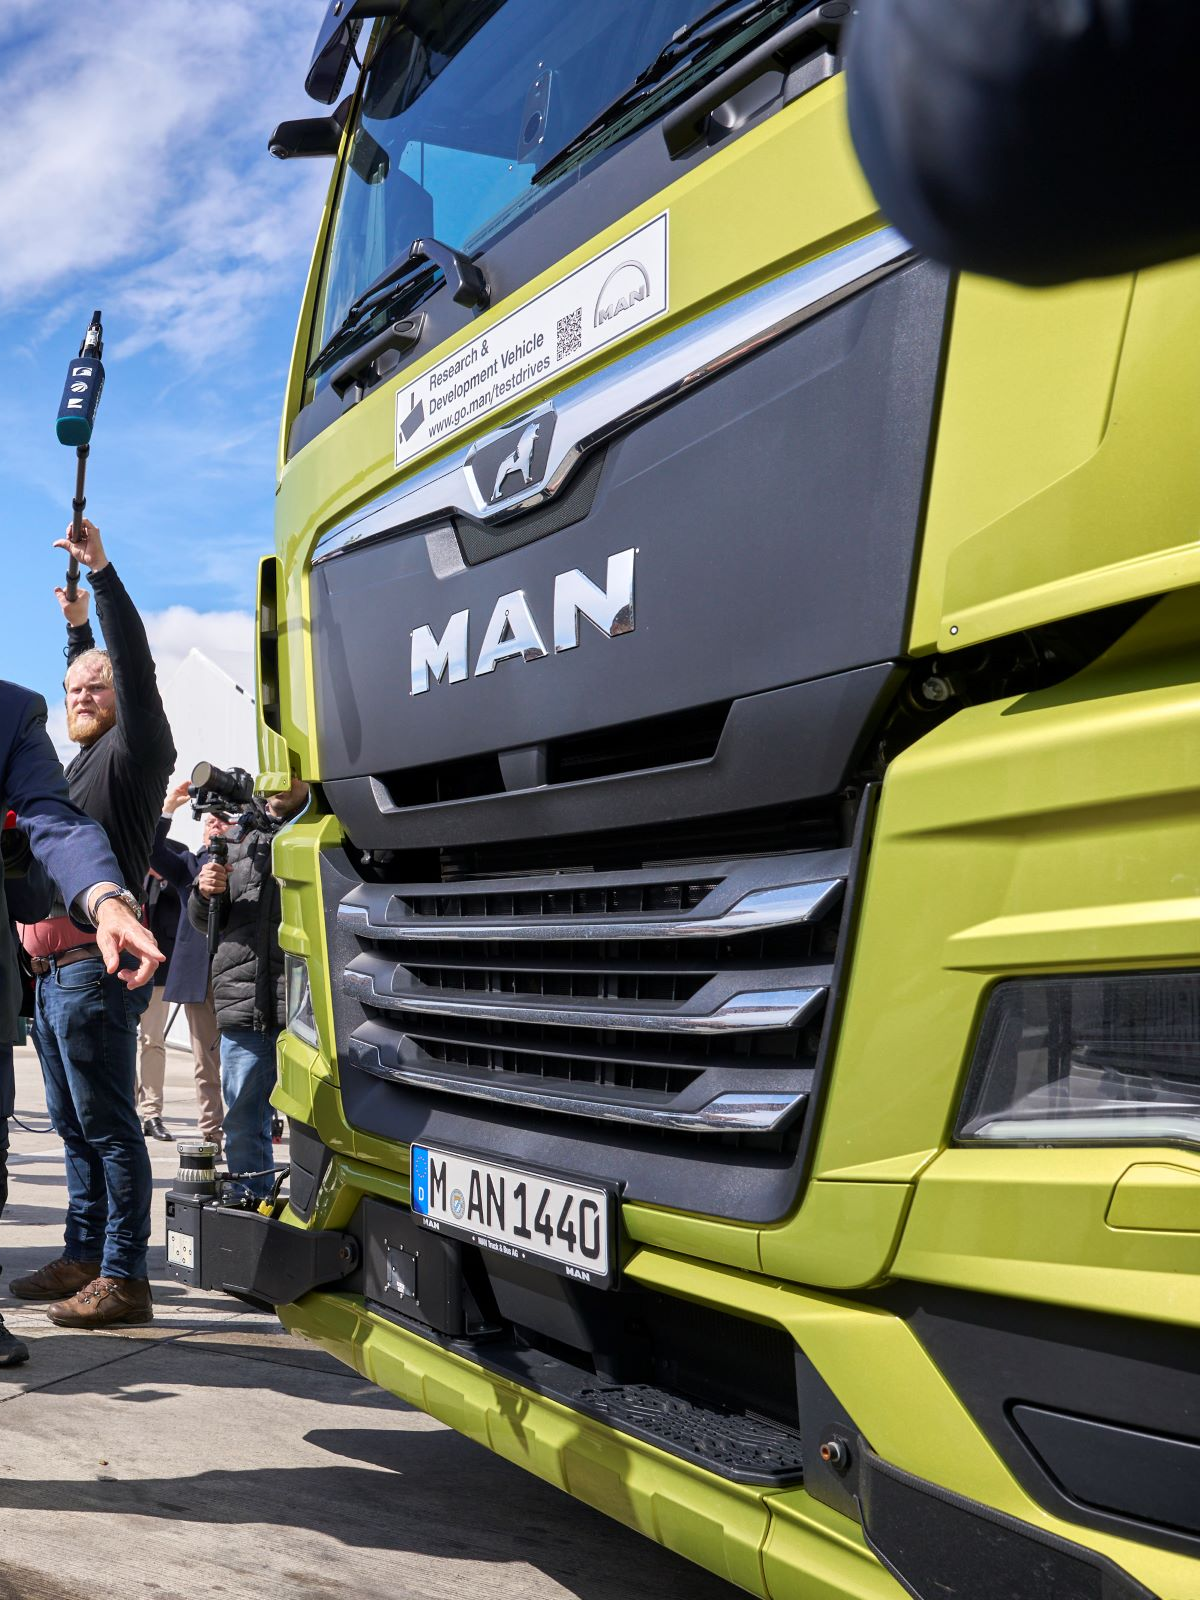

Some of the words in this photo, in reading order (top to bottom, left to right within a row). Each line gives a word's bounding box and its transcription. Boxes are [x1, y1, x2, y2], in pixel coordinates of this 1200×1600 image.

[599, 285, 645, 325] MAN
[429, 348, 478, 391] Research
[481, 339, 489, 357] &
[429, 359, 498, 415] Development
[501, 333, 544, 369] Vehicle
[428, 355, 550, 438] www.go.man/testdrives
[411, 547, 636, 696] MAN
[418, 1186, 425, 1202] D
[422, 1217, 440, 1230] MAN
[565, 1266, 590, 1281] MAN
